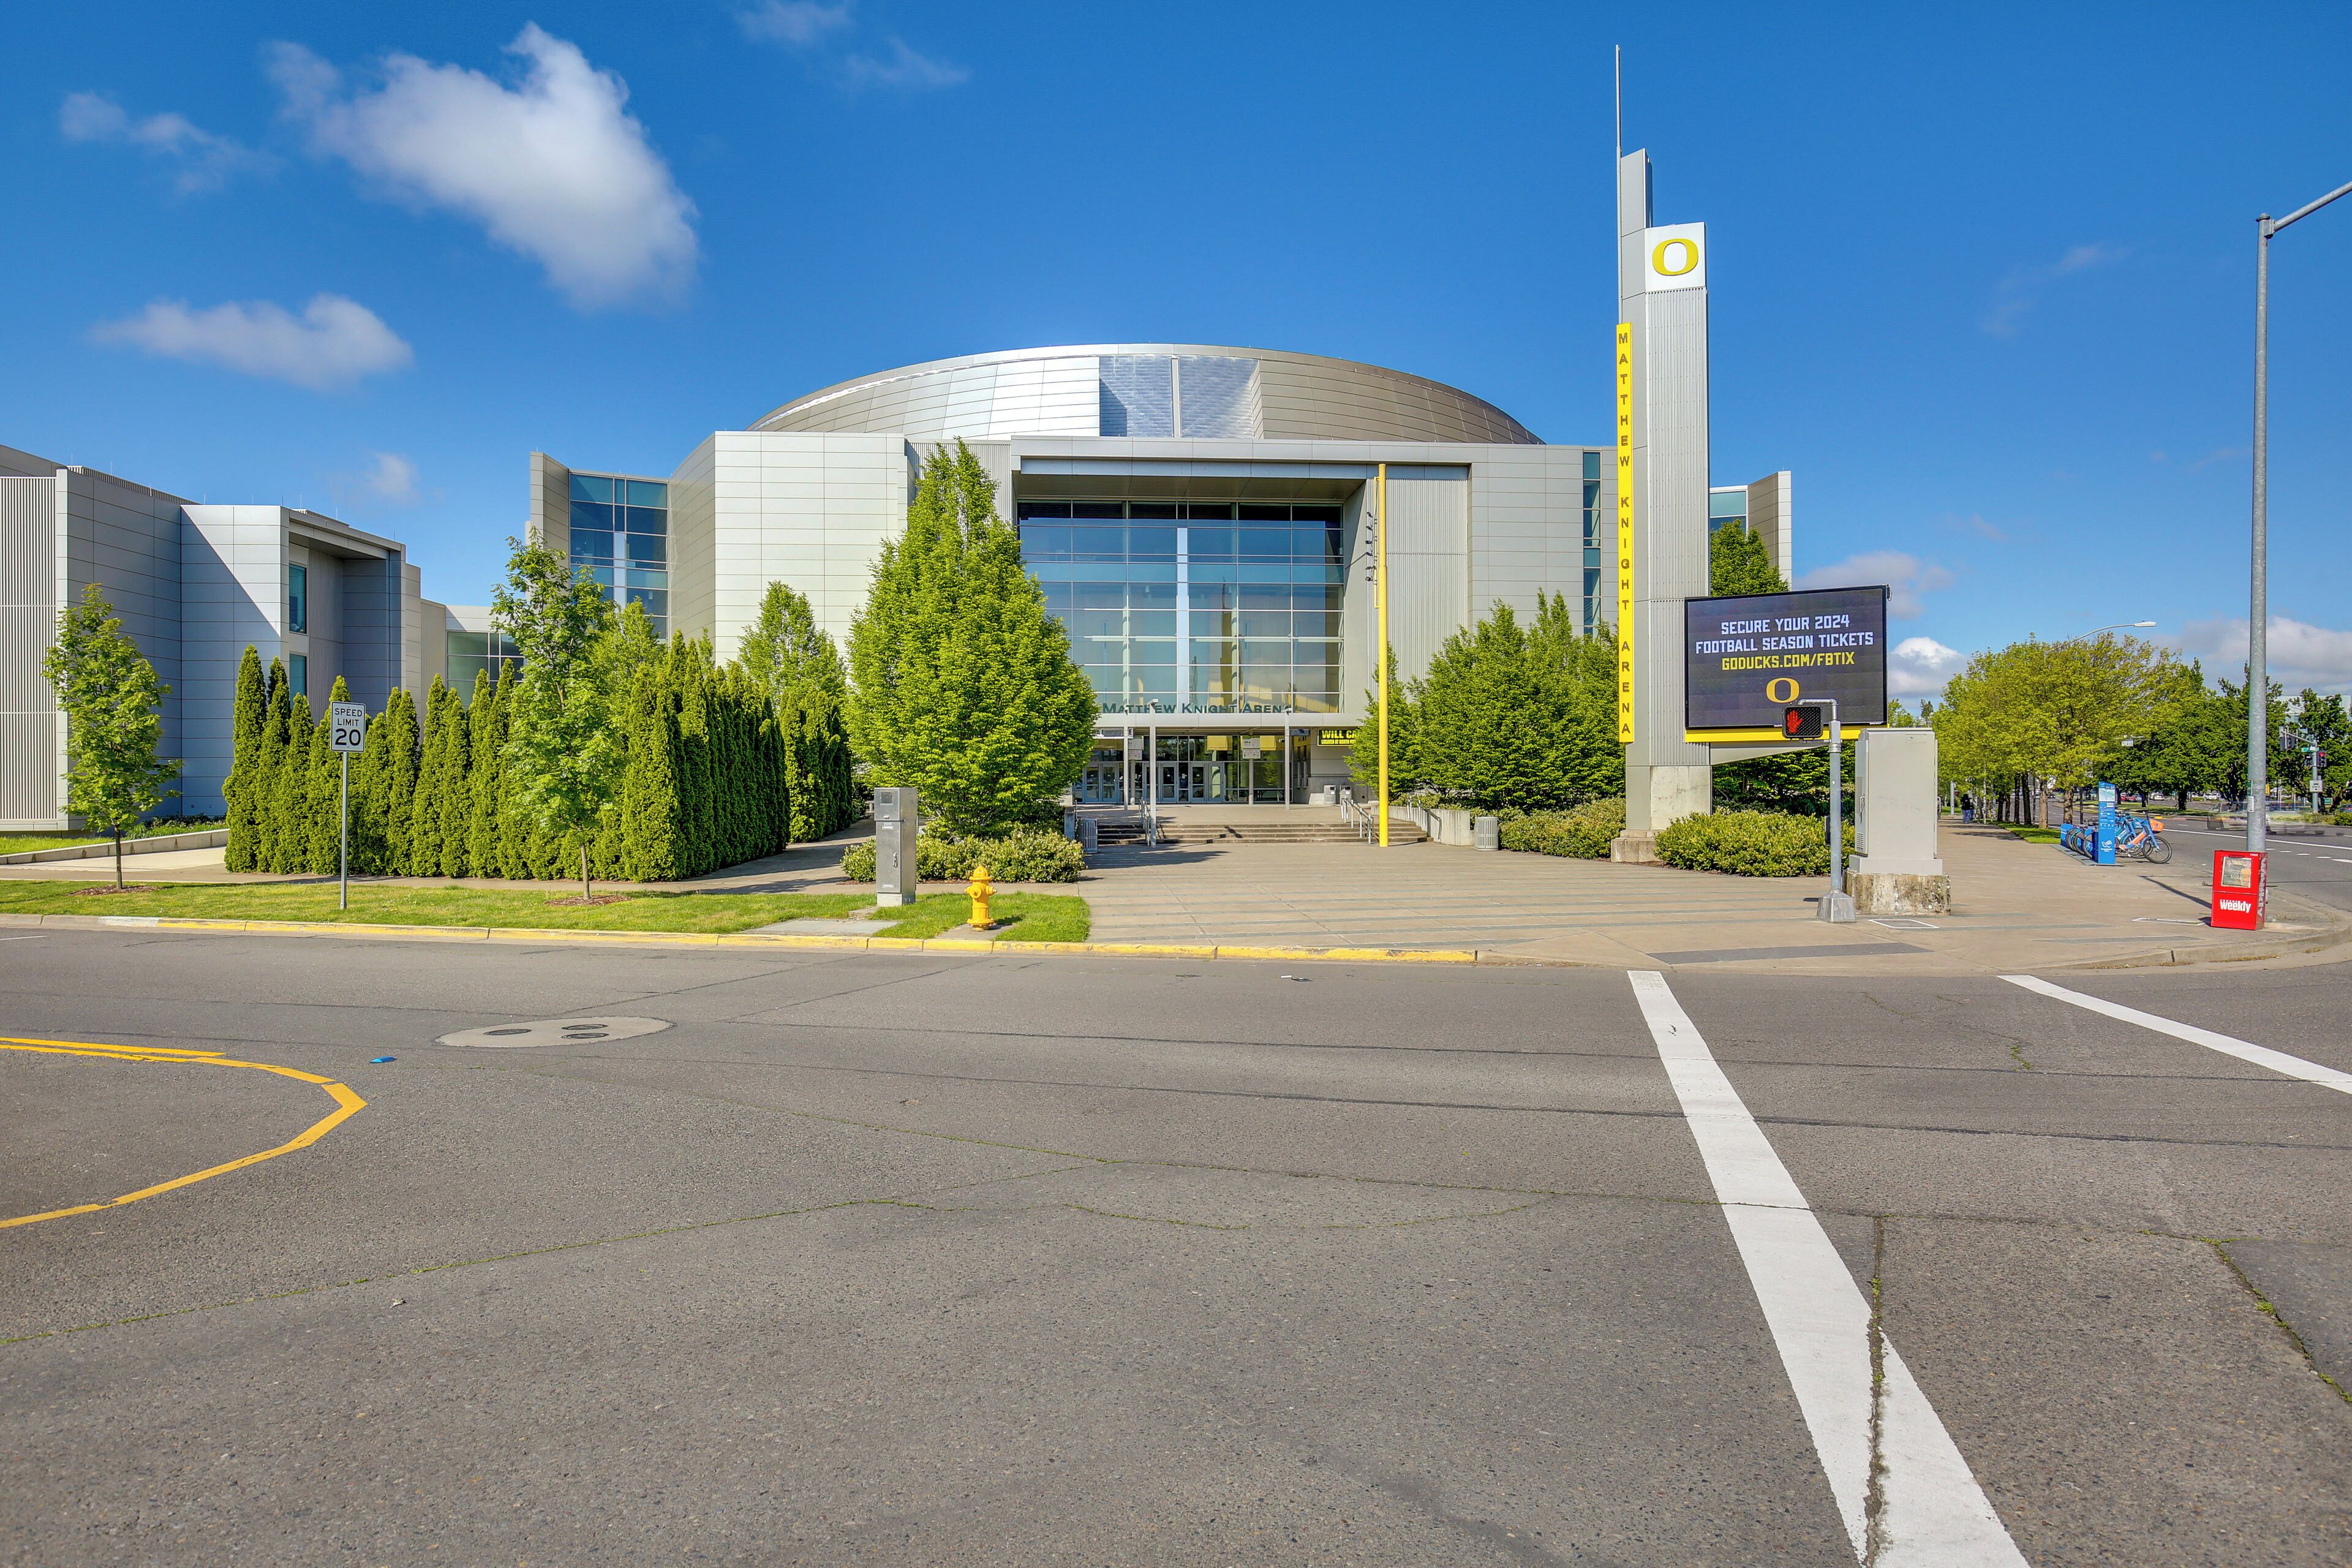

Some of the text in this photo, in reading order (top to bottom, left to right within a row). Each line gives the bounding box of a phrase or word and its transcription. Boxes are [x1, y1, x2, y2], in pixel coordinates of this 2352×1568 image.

[1652, 238, 1698, 276] O
[1618, 332, 1630, 734] MATTHEW KNIGHT ARENA
[1721, 614, 1850, 635] SECURE YOUR 2024
[1695, 631, 1874, 654] FOOTBALL SEASON TICKETS
[1722, 651, 1855, 671] GODUCKS.COM/FBTIX
[1766, 677, 1800, 704] O
[334, 708, 363, 717] SPEED
[1102, 703, 1176, 714] MATTHEW
[1182, 703, 1238, 714] KNIGHT
[337, 718, 359, 726] LIMIT
[334, 728, 361, 746] 20
[1321, 730, 1357, 739] WILL CA
[2220, 900, 2252, 913] weekly
